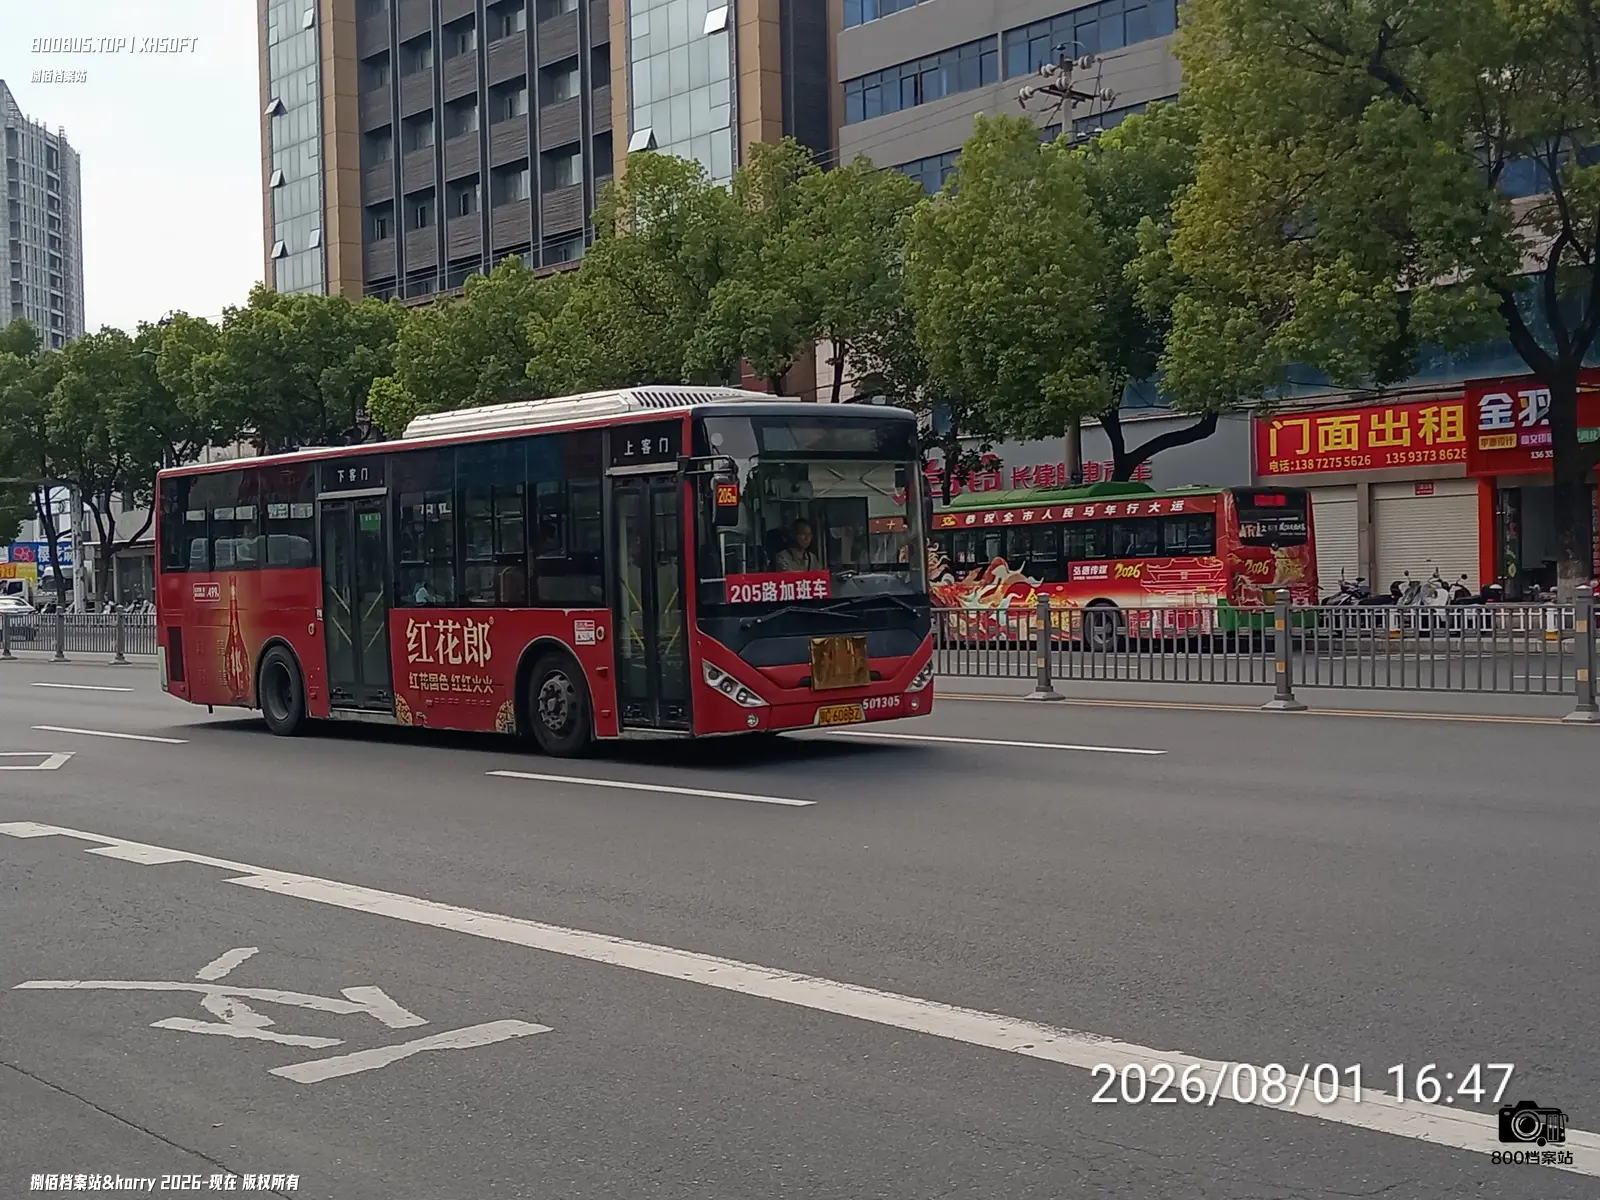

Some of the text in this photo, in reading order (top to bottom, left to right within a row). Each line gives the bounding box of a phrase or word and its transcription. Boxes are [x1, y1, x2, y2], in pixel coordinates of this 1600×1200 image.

[1269, 405, 1466, 457] 门面出租
[624, 437, 669, 456] 上客门
[337, 467, 368, 483] 下客门
[965, 500, 1185, 526] 恭祝全市人民马年行大运
[1114, 562, 1144, 579] 2026
[1244, 558, 1273, 576] 2026
[730, 579, 828, 603] 205路加班车
[405, 616, 492, 668] 红花郎
